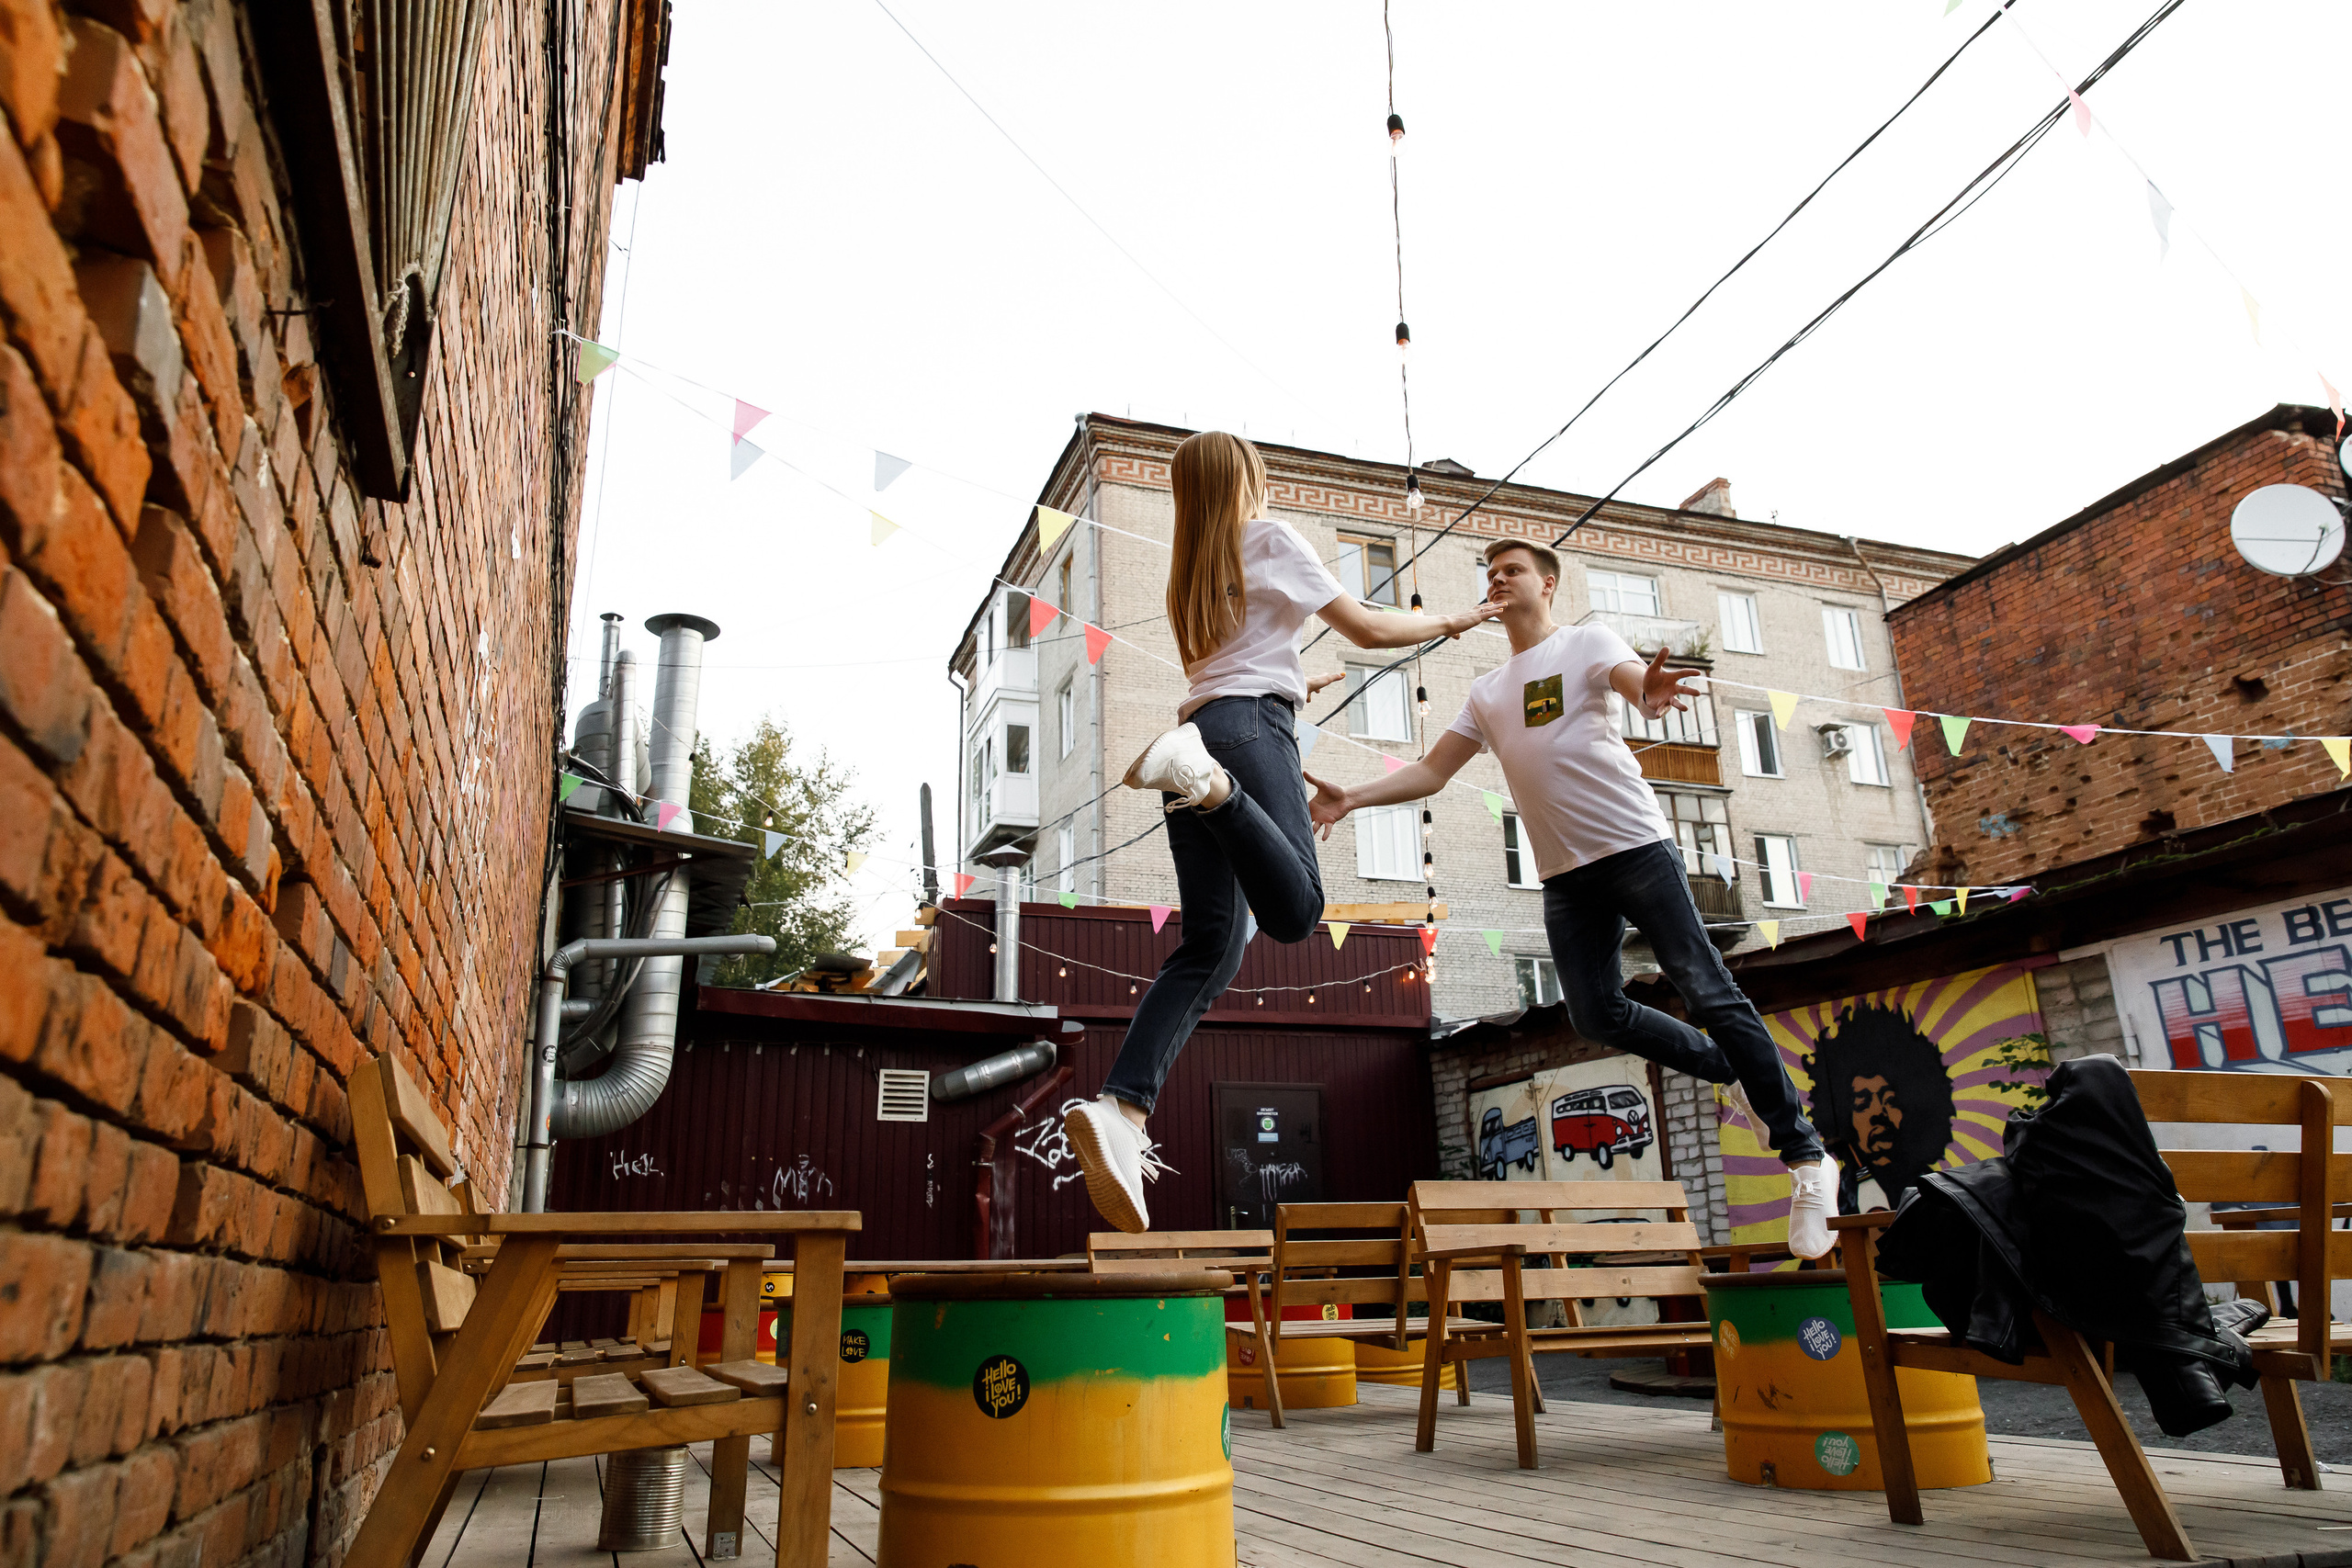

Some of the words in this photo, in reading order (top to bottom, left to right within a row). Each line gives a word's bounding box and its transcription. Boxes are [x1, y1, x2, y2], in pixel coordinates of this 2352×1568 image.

[2160, 919, 2264, 967] THE
[842, 1335, 866, 1346] MAKE
[1812, 1329, 1830, 1349] LOVE
[841, 1347, 865, 1358] LOVE
[991, 1378, 1016, 1401] LOVE
